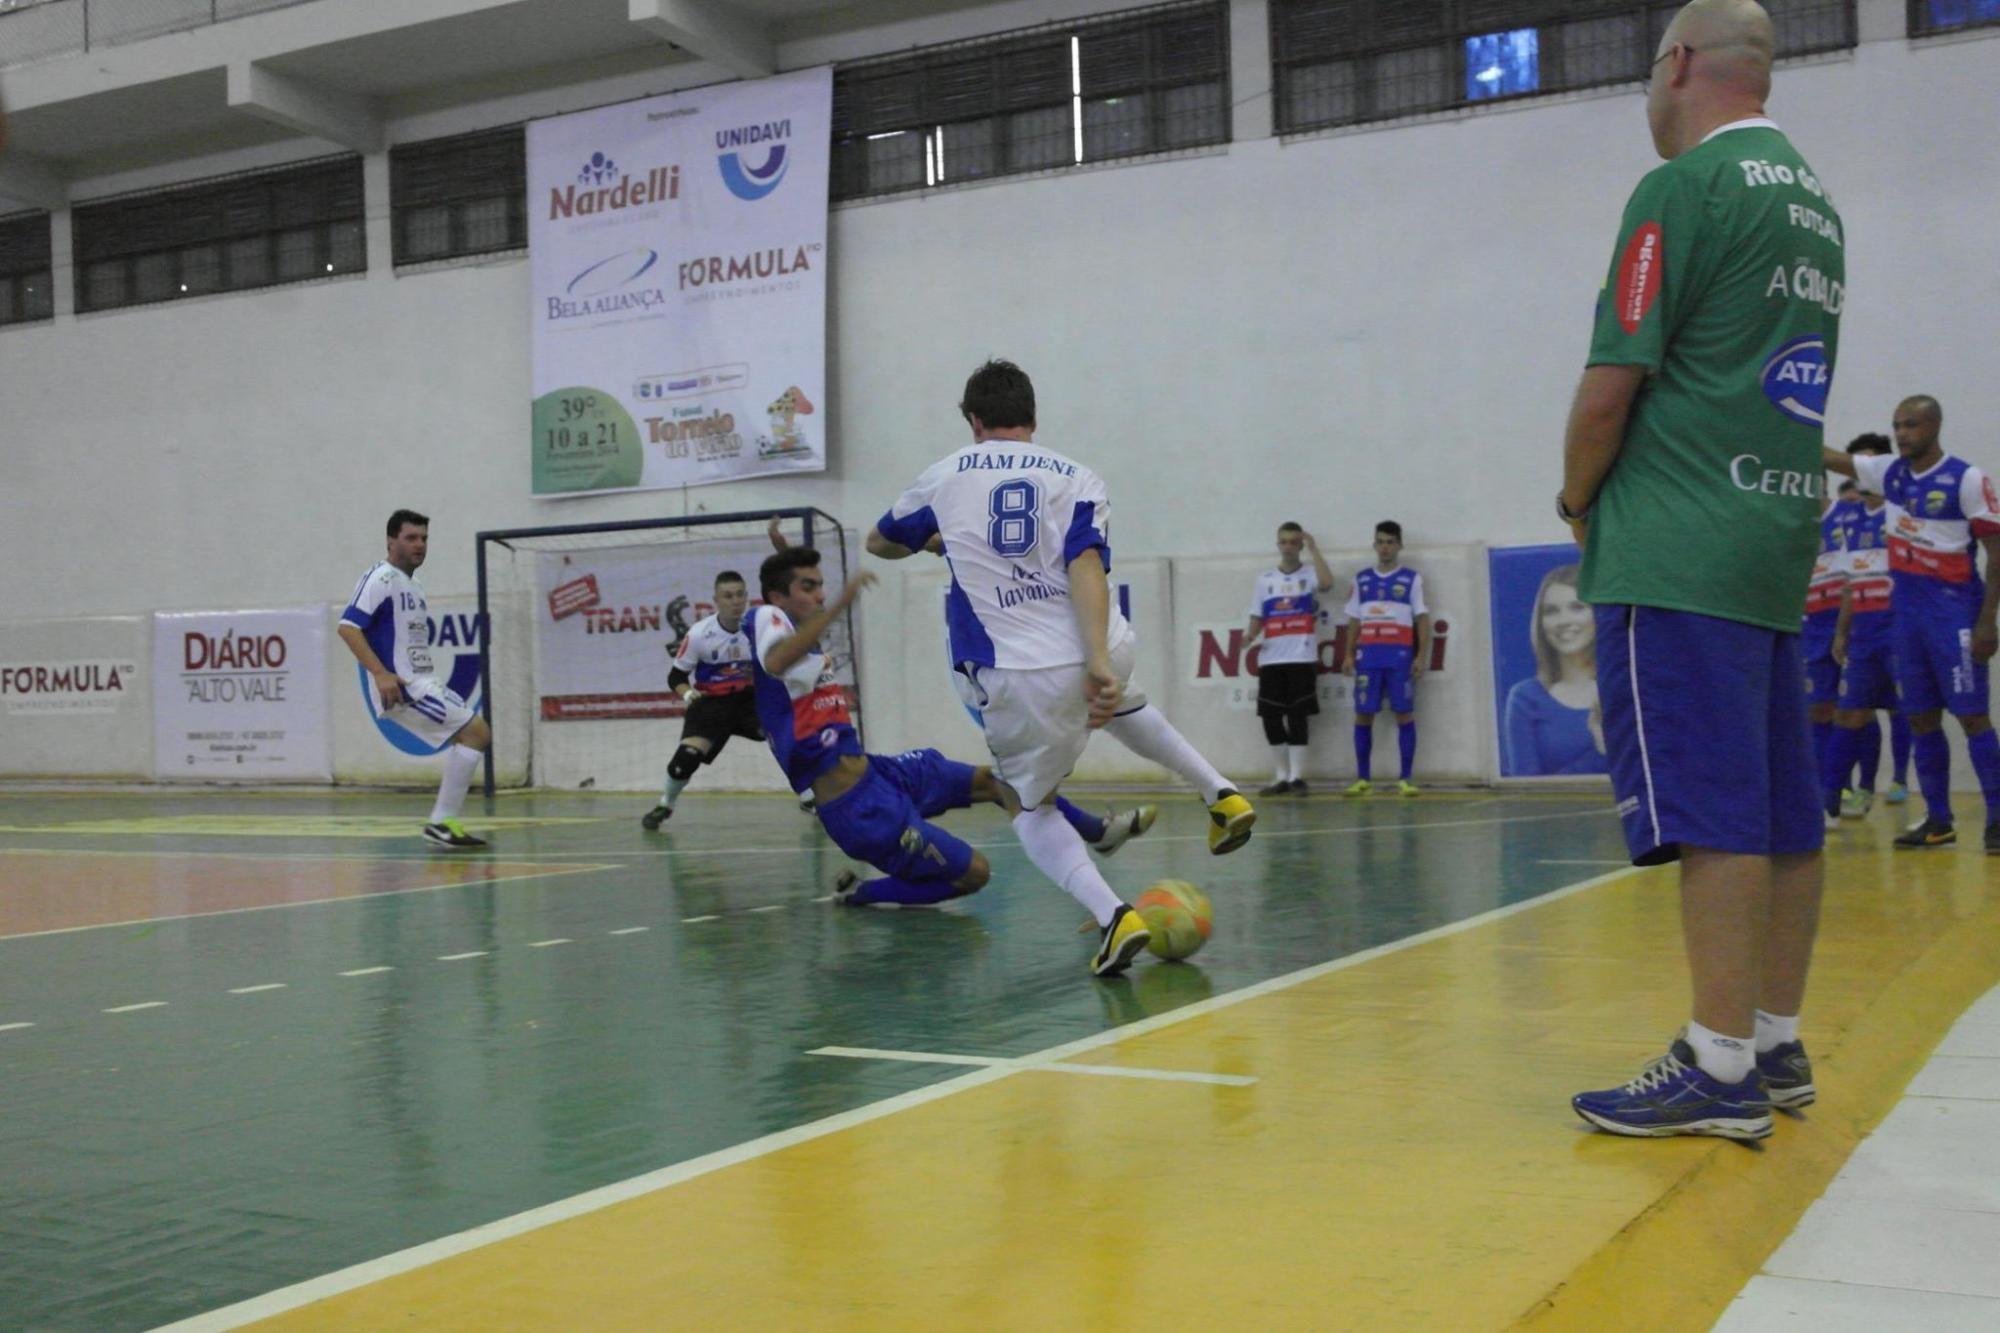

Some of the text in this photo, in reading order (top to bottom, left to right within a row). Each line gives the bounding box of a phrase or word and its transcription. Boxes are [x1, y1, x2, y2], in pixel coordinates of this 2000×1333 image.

[716, 119, 791, 149] UNIDAVI
[1739, 160, 1795, 187] Rio
[549, 165, 681, 221] Nardelli
[1765, 265, 1789, 297] A
[547, 289, 665, 320] BELA ALIANÇA
[547, 427, 570, 449] 10
[596, 422, 618, 446] 21
[957, 453, 1078, 478] DIAM DENE
[987, 477, 1039, 558] 8
[185, 628, 287, 670] DIÁRIO
[188, 676, 287, 703] ALTO VALE
